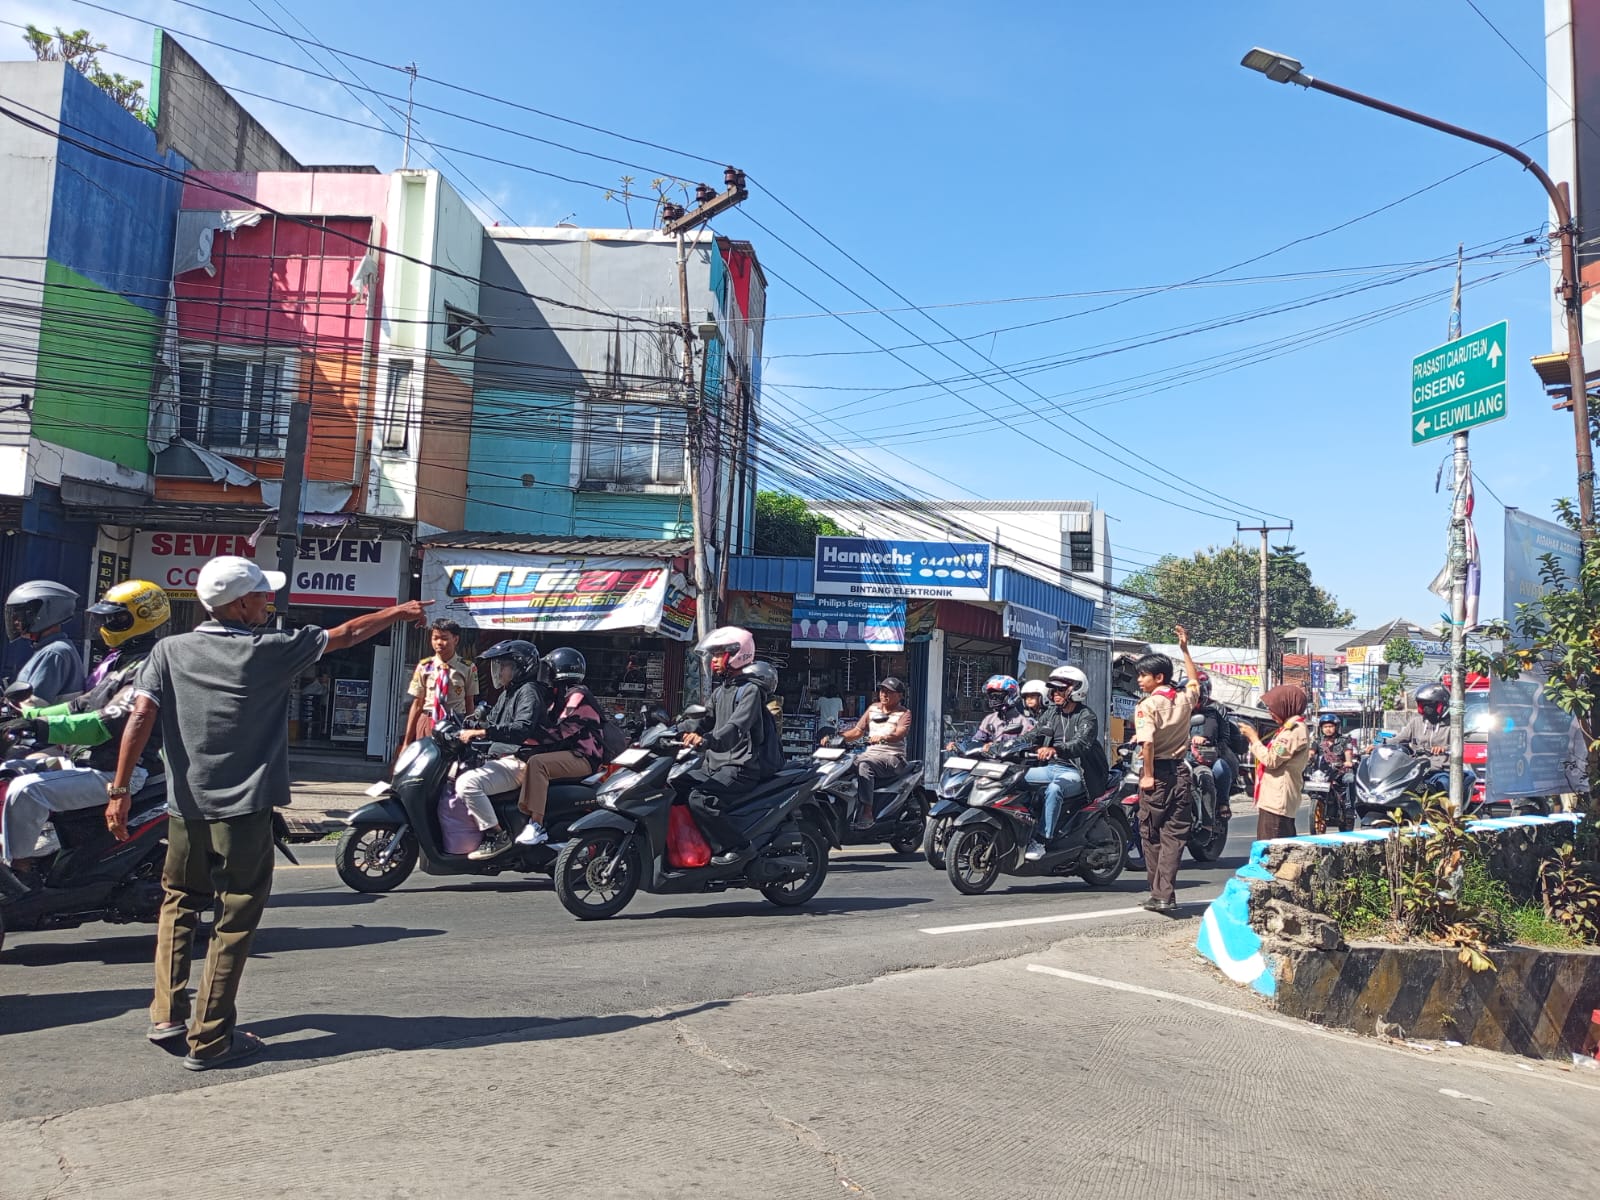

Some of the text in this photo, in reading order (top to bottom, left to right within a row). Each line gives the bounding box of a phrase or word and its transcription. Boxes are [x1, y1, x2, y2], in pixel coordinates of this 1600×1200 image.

[1413, 337, 1488, 382] PRASASTI CIARUTEUN
[1413, 370, 1465, 404] CISEENG
[1433, 393, 1503, 431] LEUWILIANG
[151, 533, 256, 558] SEVEN
[276, 538, 382, 563] EVEN
[823, 546, 912, 565] Hannochs
[297, 571, 356, 591] GAME
[850, 585, 953, 597] BINTANG ELEKTRONIK
[818, 599, 893, 609] Philips Bergaransi
[1009, 614, 1045, 638] Hannochs
